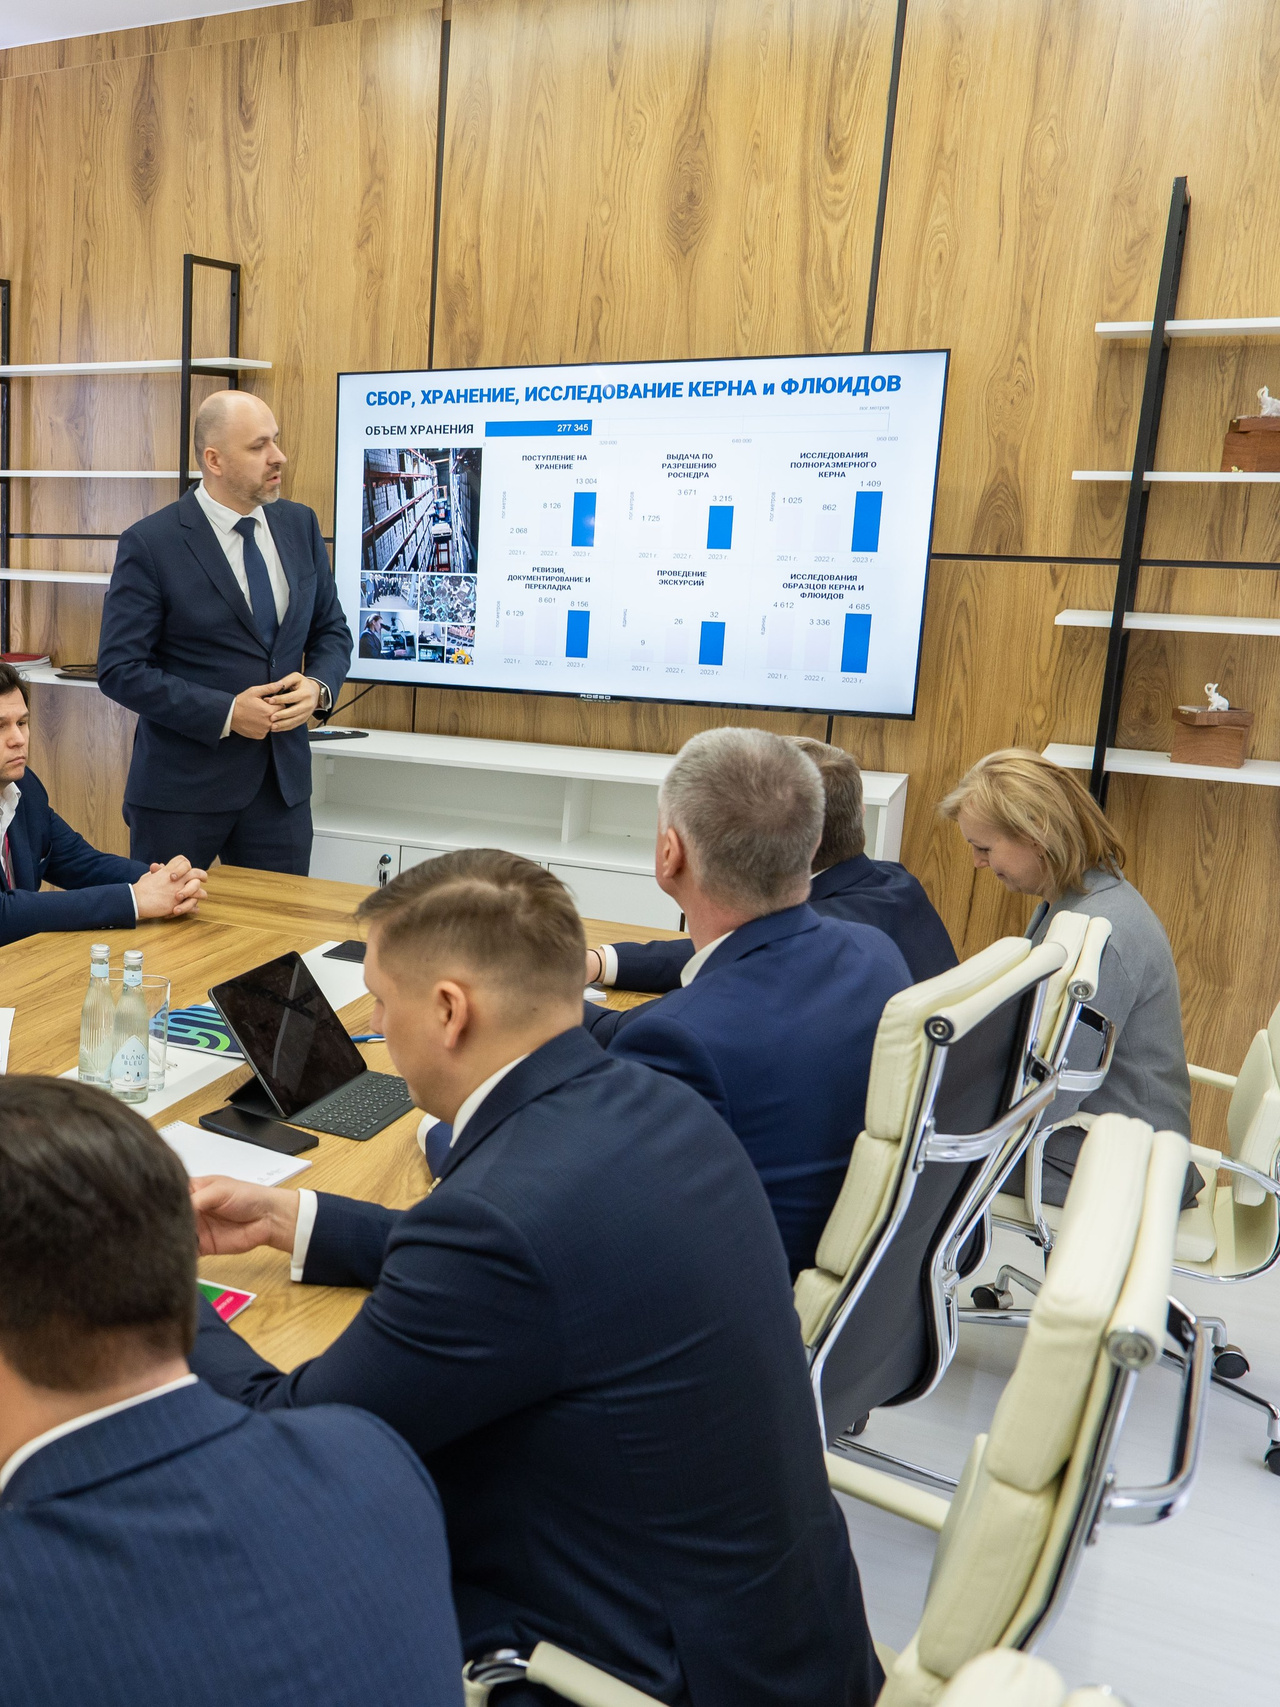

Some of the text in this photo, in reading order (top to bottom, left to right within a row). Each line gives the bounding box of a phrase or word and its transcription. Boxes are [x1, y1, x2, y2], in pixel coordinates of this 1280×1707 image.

[366, 375, 902, 408] СБОР, ХРАНЕНИЕ, ИССЛЕДОВАНИЕ КЕРНА и ФЛЮИДОВ
[366, 424, 474, 436] ОБЪЕМ ХРАНЕНИЯ
[557, 423, 589, 432] 277 345
[800, 592, 844, 600] ФЛЮИДОВ
